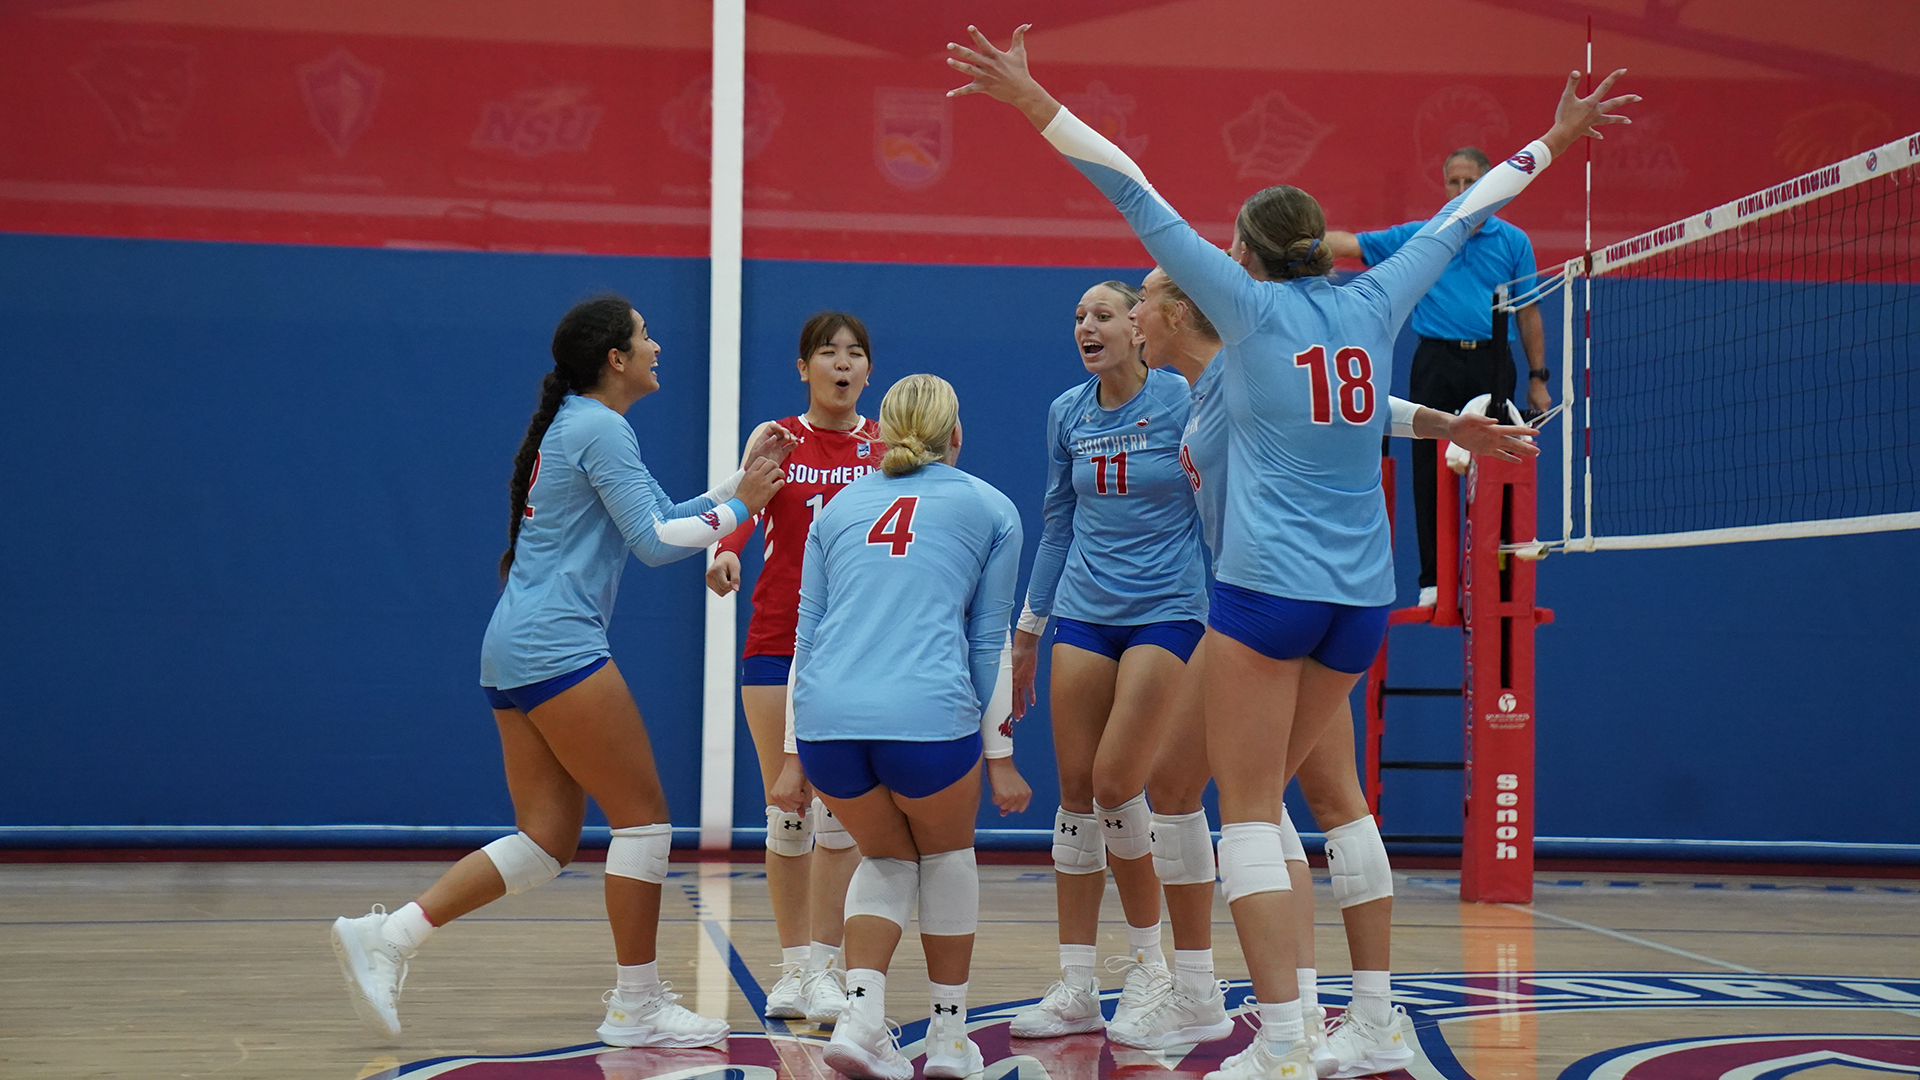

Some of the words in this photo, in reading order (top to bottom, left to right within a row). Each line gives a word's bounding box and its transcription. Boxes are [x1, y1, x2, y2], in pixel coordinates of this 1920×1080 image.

[480, 107, 598, 152] NSU
[1294, 344, 1376, 426] 18
[1077, 433, 1148, 455] SOUTHERN
[1090, 451, 1128, 496] 11
[866, 495, 920, 557] 4
[1496, 773, 1518, 859] senoh
